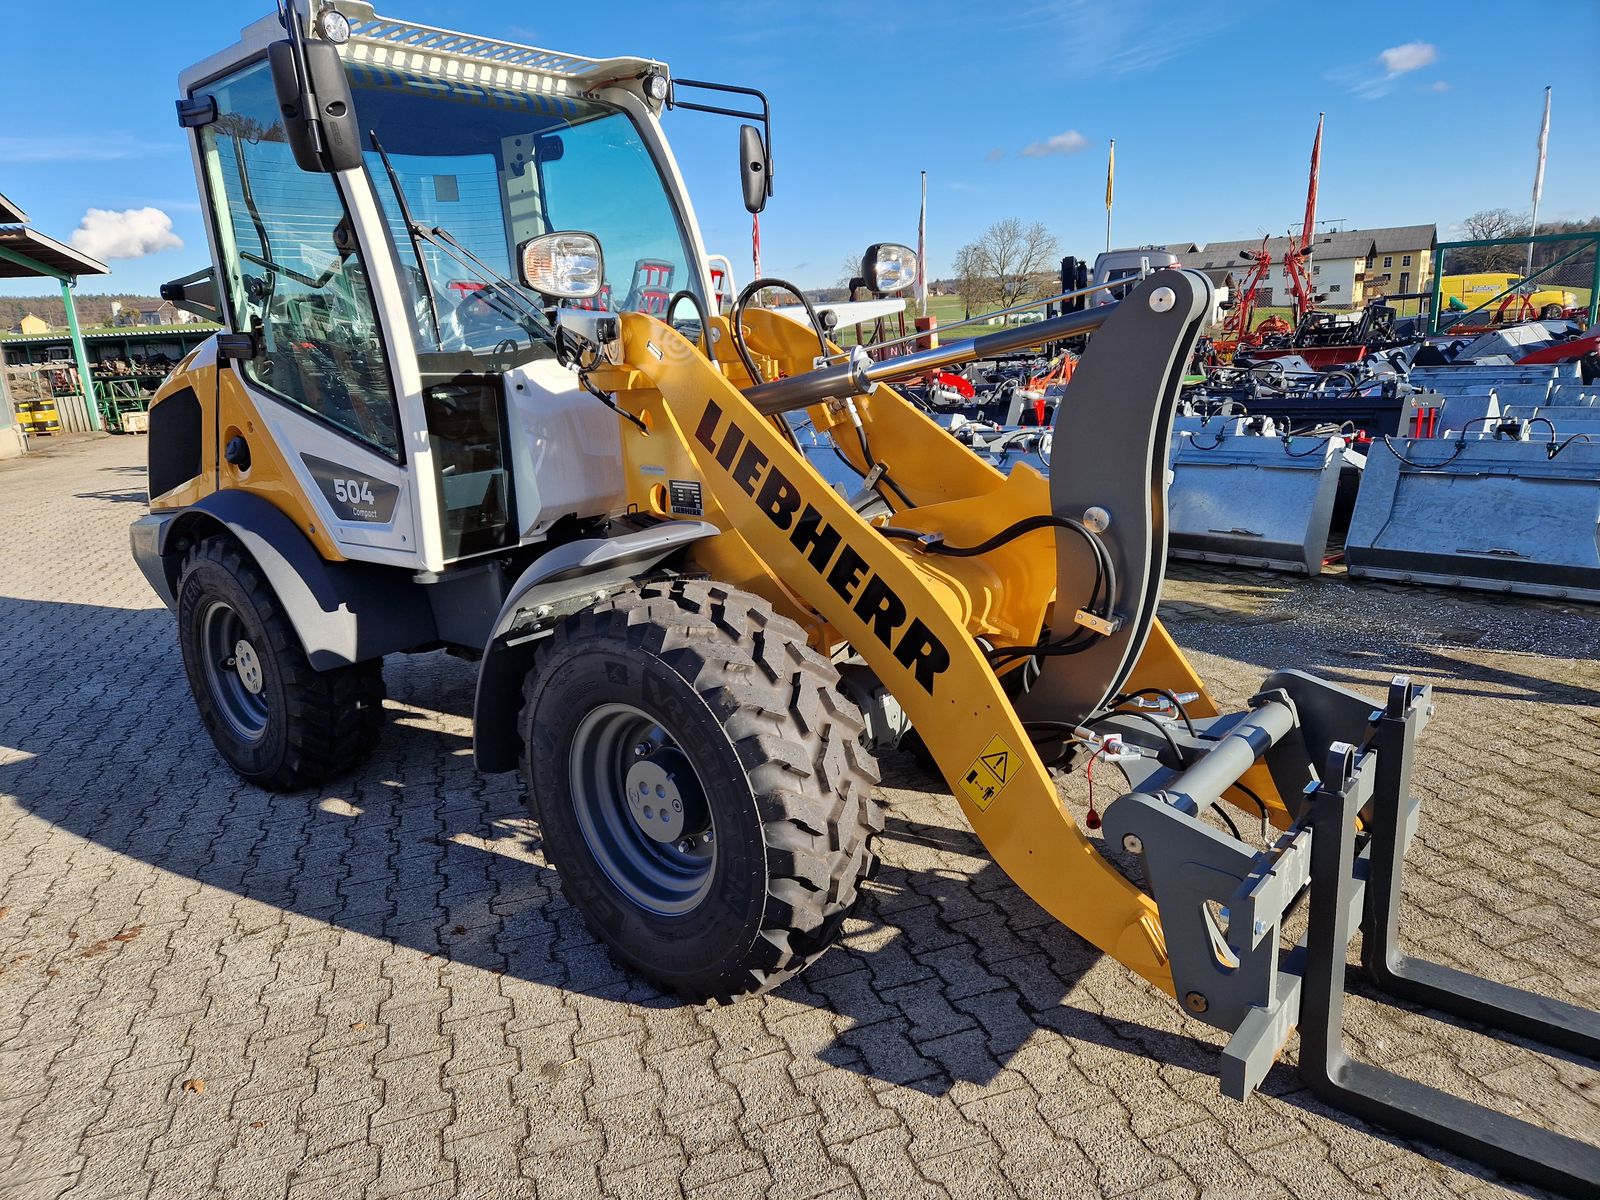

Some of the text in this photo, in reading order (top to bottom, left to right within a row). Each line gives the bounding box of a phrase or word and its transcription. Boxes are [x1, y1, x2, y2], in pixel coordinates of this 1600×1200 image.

[333, 479, 375, 505] 504
[352, 507, 378, 518] Compact
[672, 506, 703, 516] LIEBHERR
[695, 398, 951, 696] LIEBHERR
